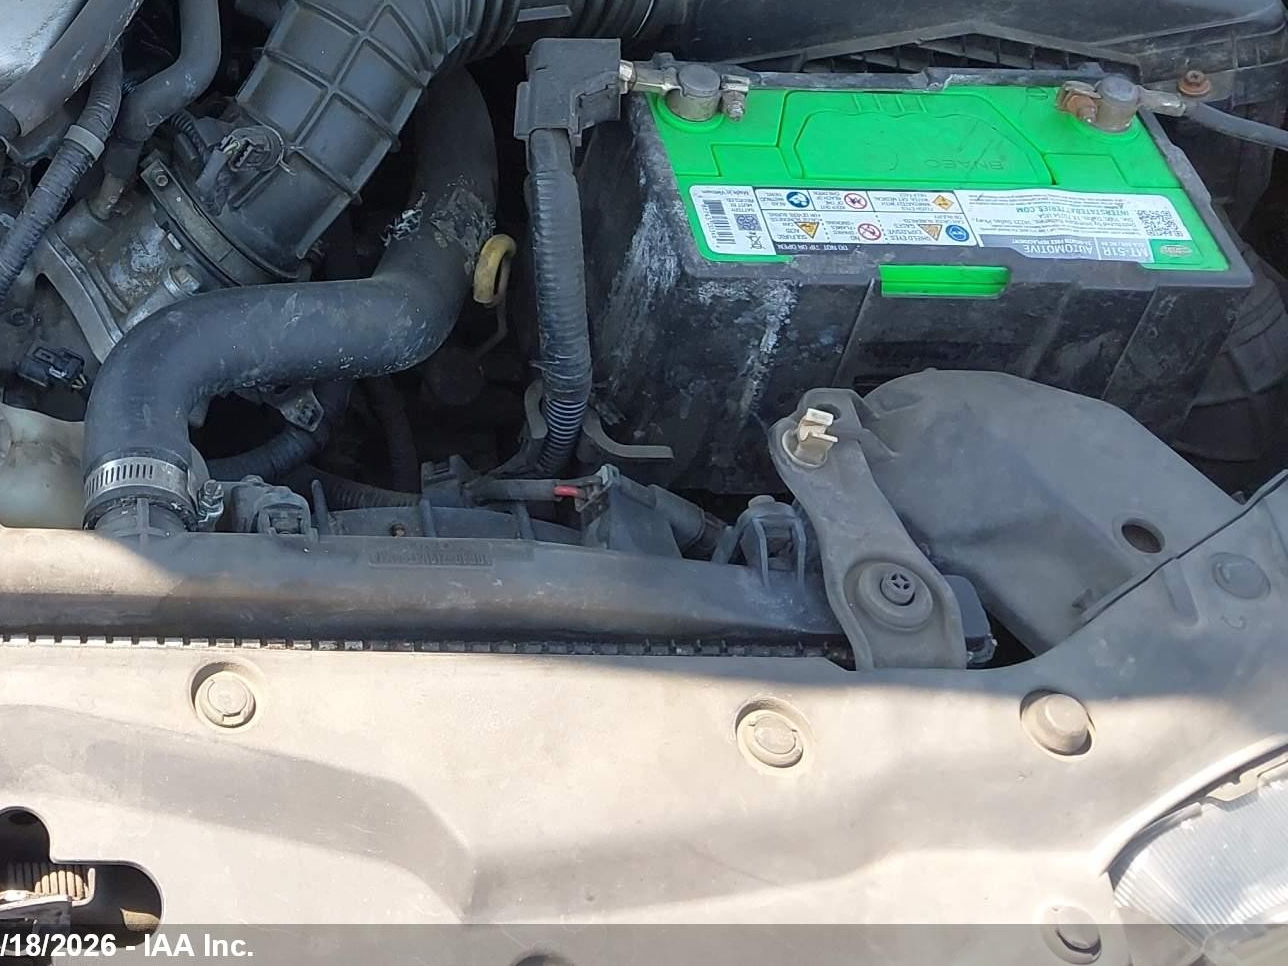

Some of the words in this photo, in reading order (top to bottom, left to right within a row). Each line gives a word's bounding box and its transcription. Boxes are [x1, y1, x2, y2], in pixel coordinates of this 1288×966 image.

[1016, 206, 1129, 216] INTERSTATEBATTERIES.COM
[1023, 244, 1093, 255] AUTOMOTIVE
[1102, 246, 1149, 258] MT-51R
